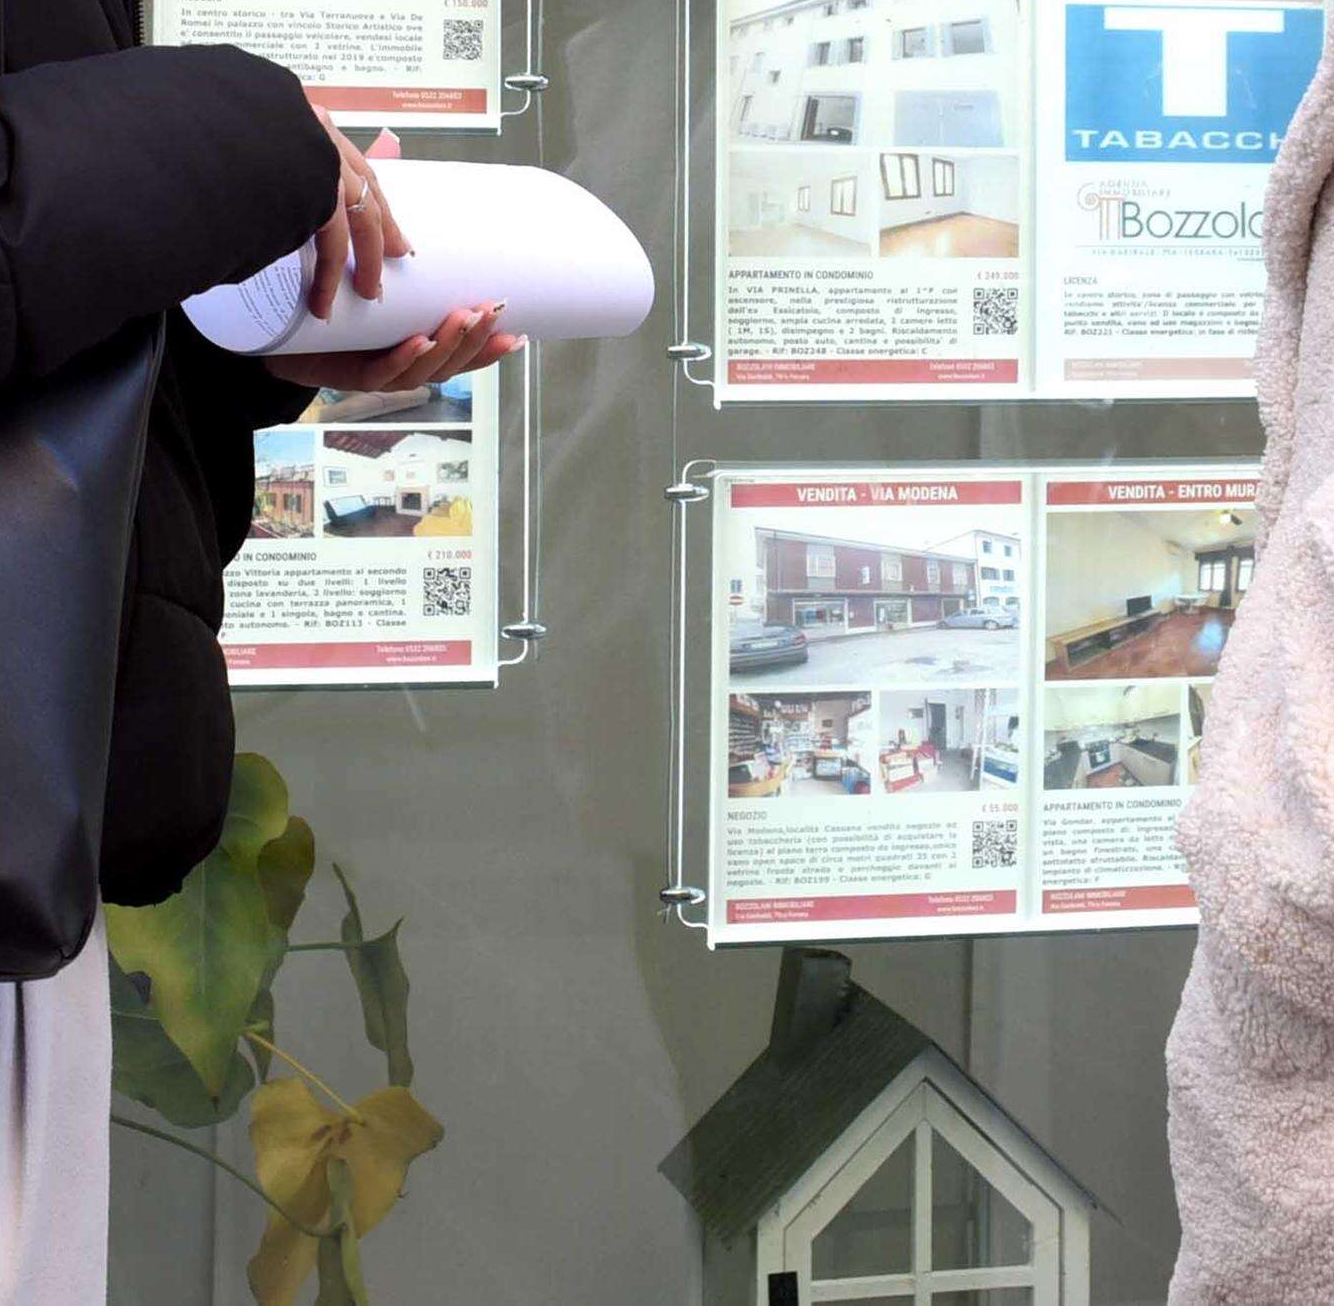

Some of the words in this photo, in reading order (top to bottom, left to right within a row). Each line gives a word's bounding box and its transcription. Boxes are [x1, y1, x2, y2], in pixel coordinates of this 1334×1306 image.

[1103, 7, 1285, 117] T
[727, 269, 801, 279] APPARTAMENTO
[803, 270, 813, 279] IN
[815, 269, 873, 280] CONDOMINIO
[796, 486, 857, 502] VENDITA
[869, 484, 895, 501] VIA
[897, 485, 958, 501] MODENA
[1107, 484, 1165, 499] VENDITA
[1177, 483, 1222, 498] ENTRO
[242, 552, 253, 561] IN
[255, 551, 317, 562] CONDOMINIO
[1042, 800, 1113, 812] APPARTAMENTO
[1114, 800, 1124, 809] IN
[1125, 798, 1182, 809] CONDOMINIO
[726, 810, 767, 821] NEGOZIO
